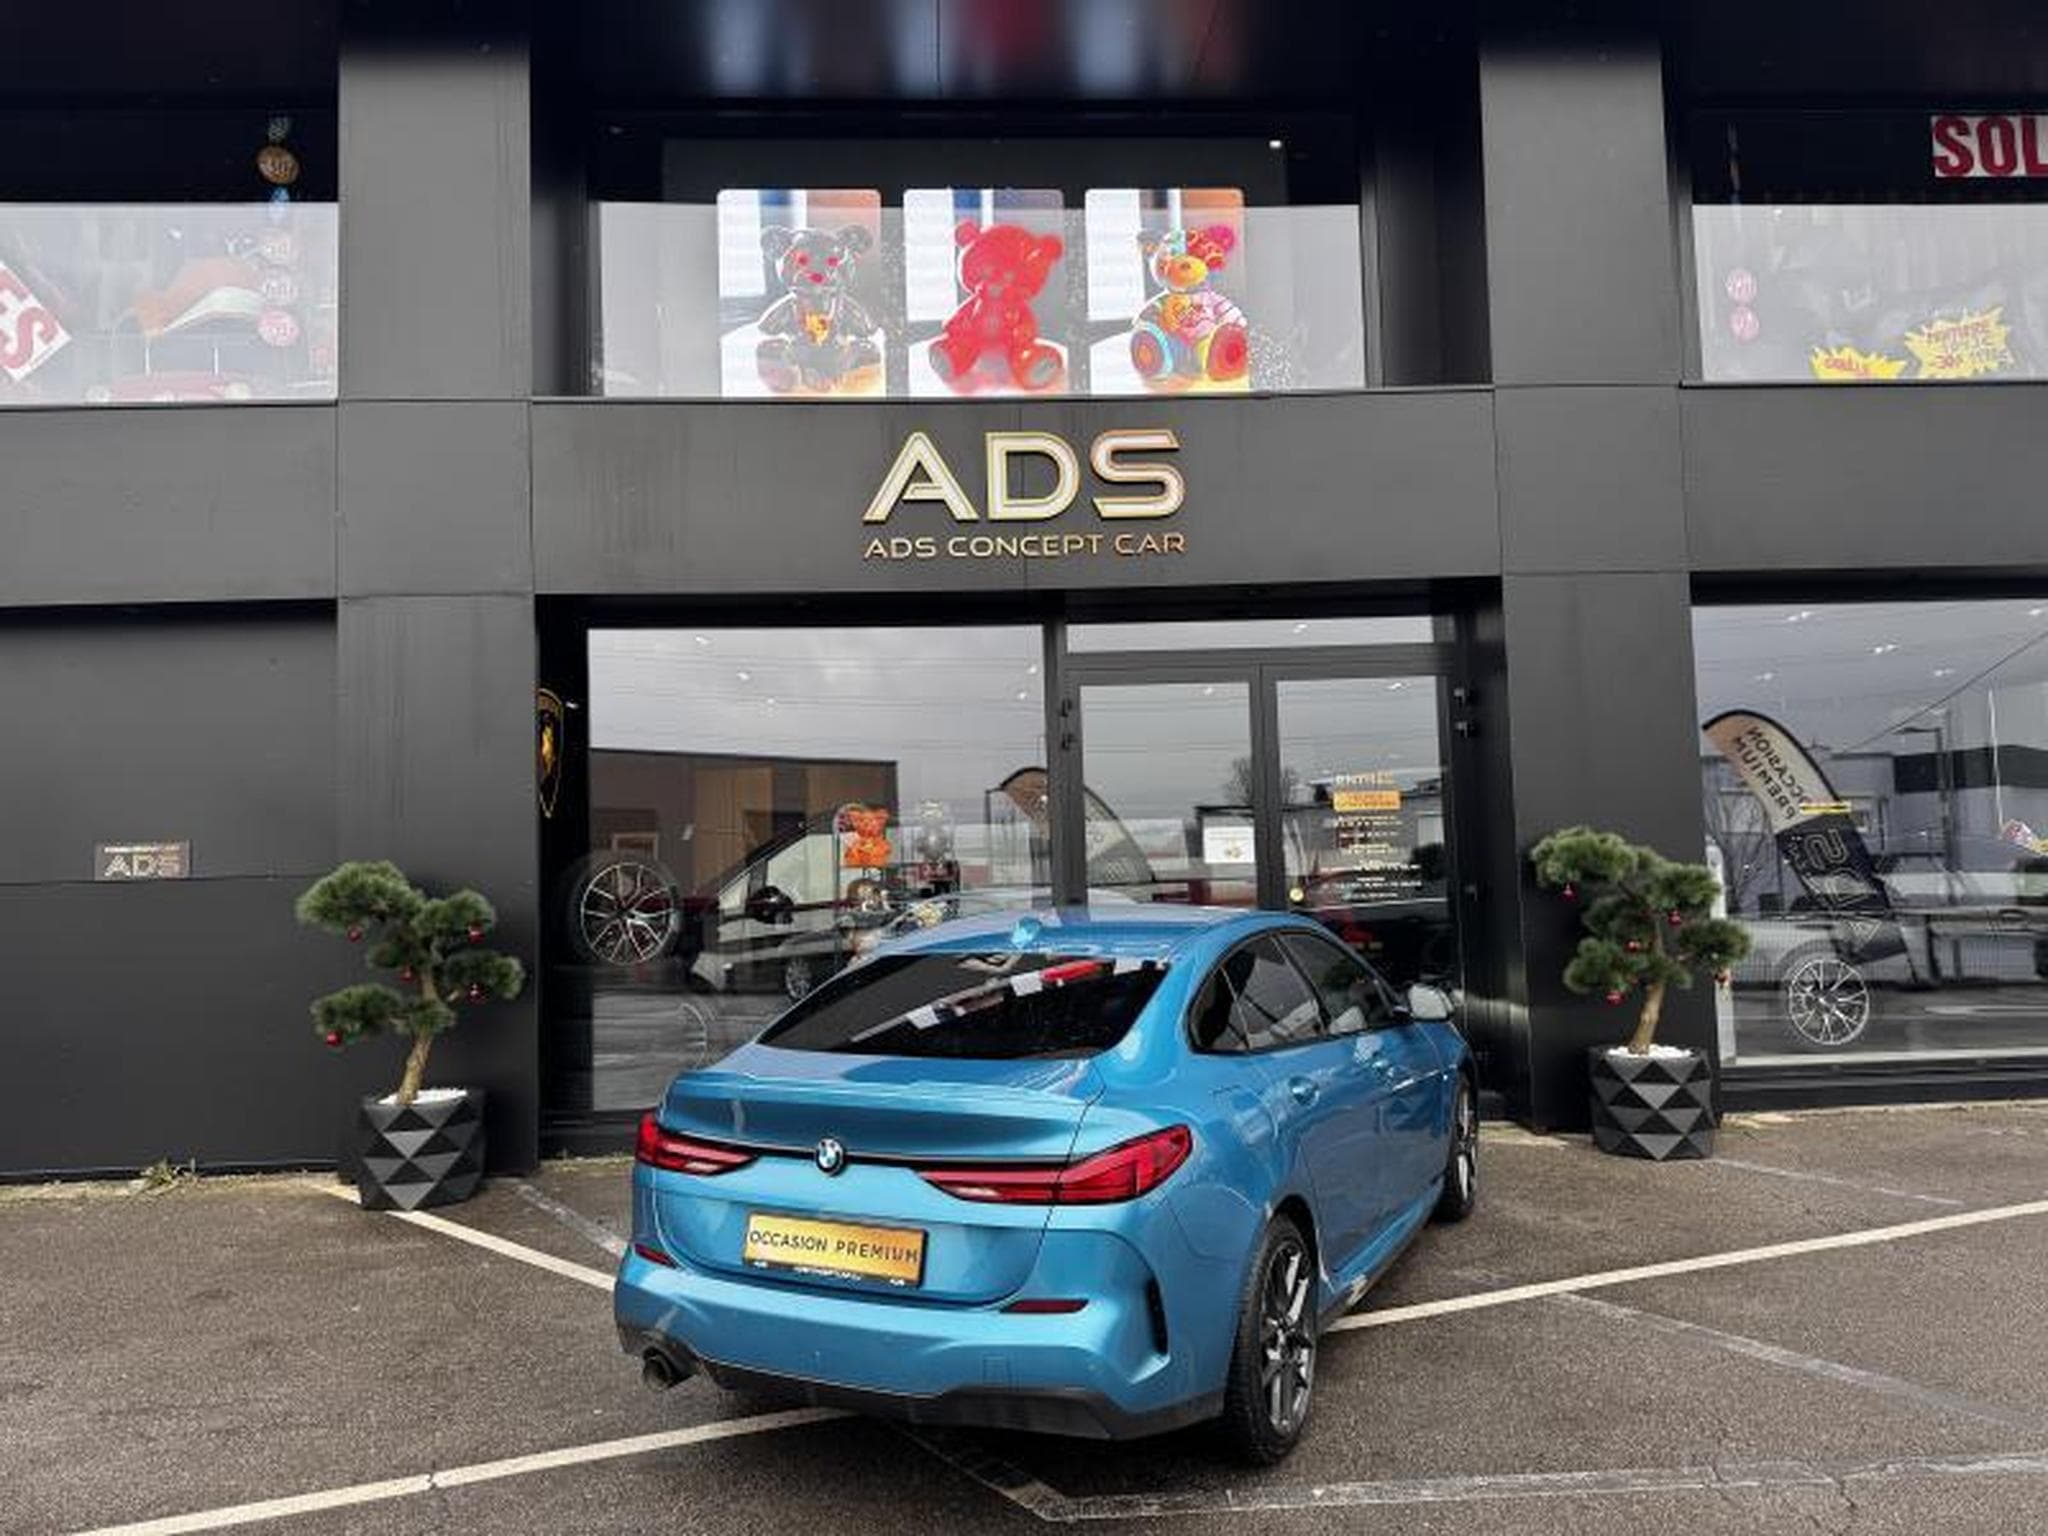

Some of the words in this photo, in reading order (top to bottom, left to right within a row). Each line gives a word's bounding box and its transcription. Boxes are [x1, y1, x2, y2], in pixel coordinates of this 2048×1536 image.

[863, 429, 1186, 522] ADS
[864, 537, 937, 559] ADS
[948, 534, 1102, 558] CONCEPT
[1115, 532, 1185, 556] CAR
[104, 854, 180, 877] ADS
[750, 1231, 828, 1252] OCCASION
[836, 1240, 918, 1263] PREMIUM
